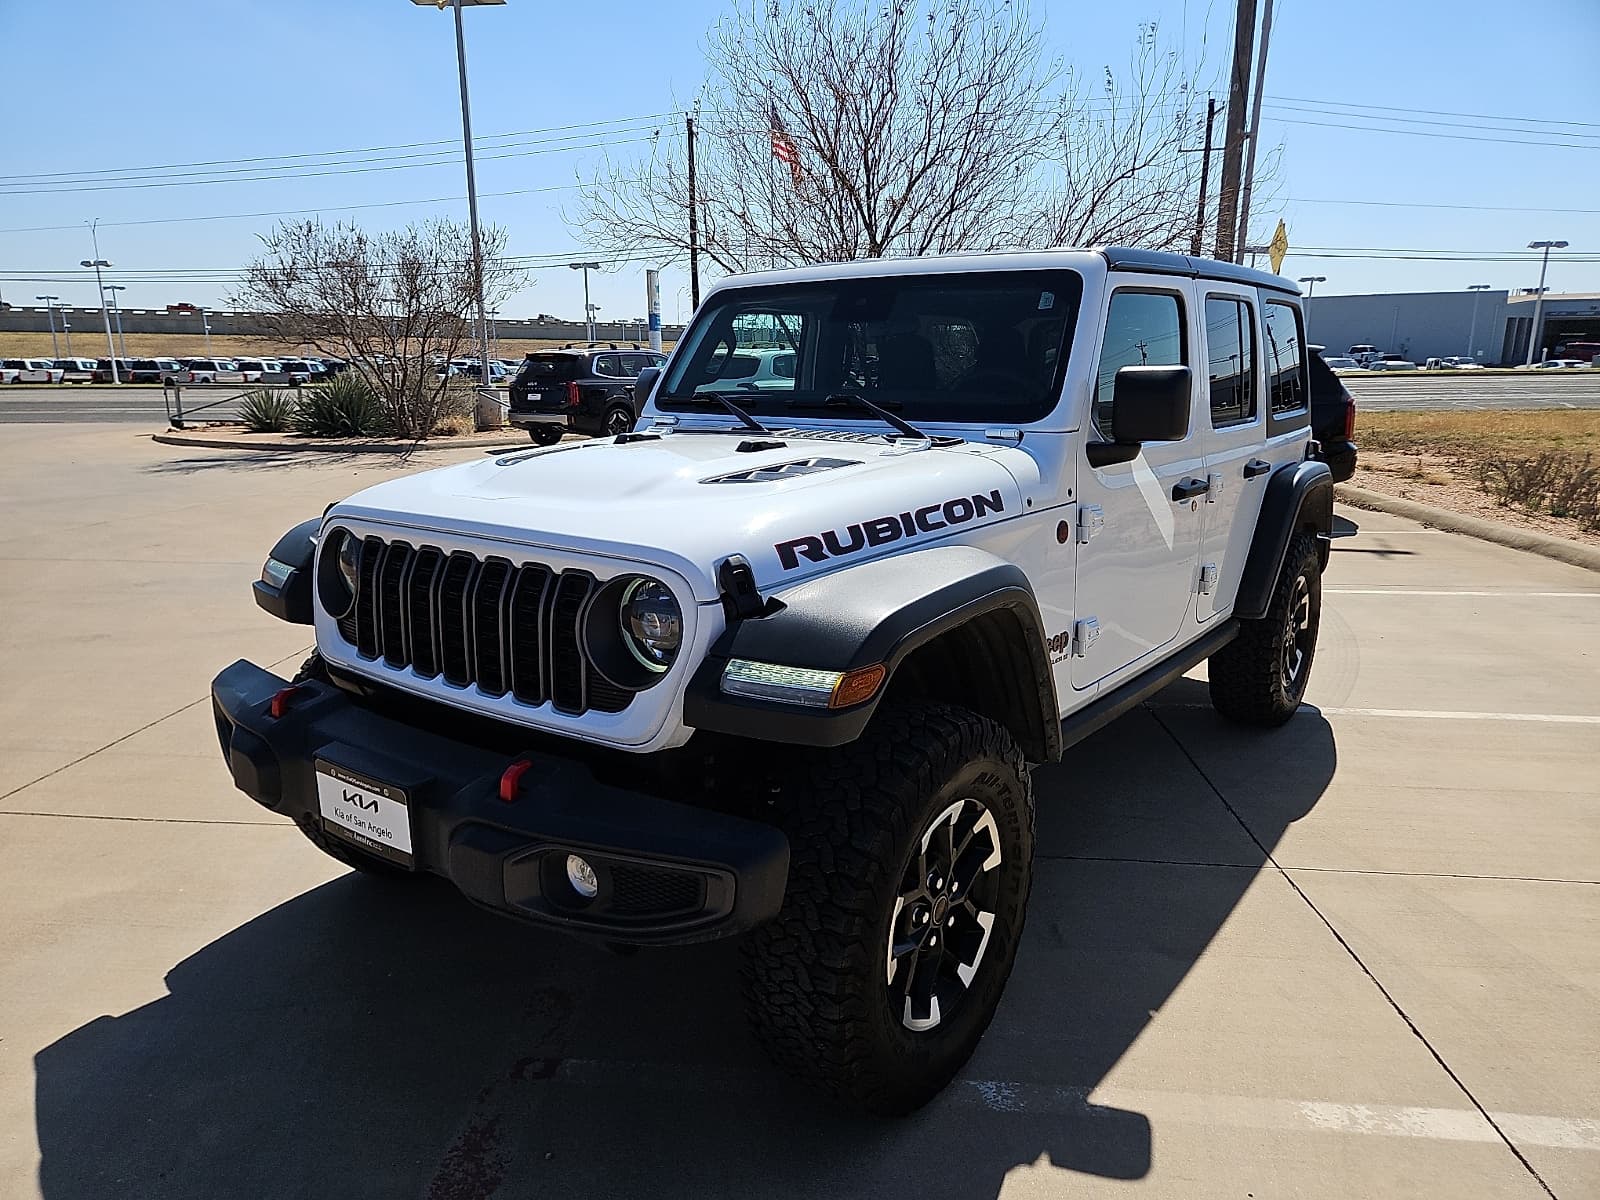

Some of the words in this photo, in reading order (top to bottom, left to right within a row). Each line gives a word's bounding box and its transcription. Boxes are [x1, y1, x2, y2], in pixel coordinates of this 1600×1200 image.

[774, 489, 1005, 571] RUBICON
[1046, 630, 1070, 654] eep
[343, 789, 378, 813] KIA
[334, 806, 345, 819] Kia
[346, 814, 353, 822] of
[354, 816, 366, 828] San
[368, 822, 393, 839] Angelo
